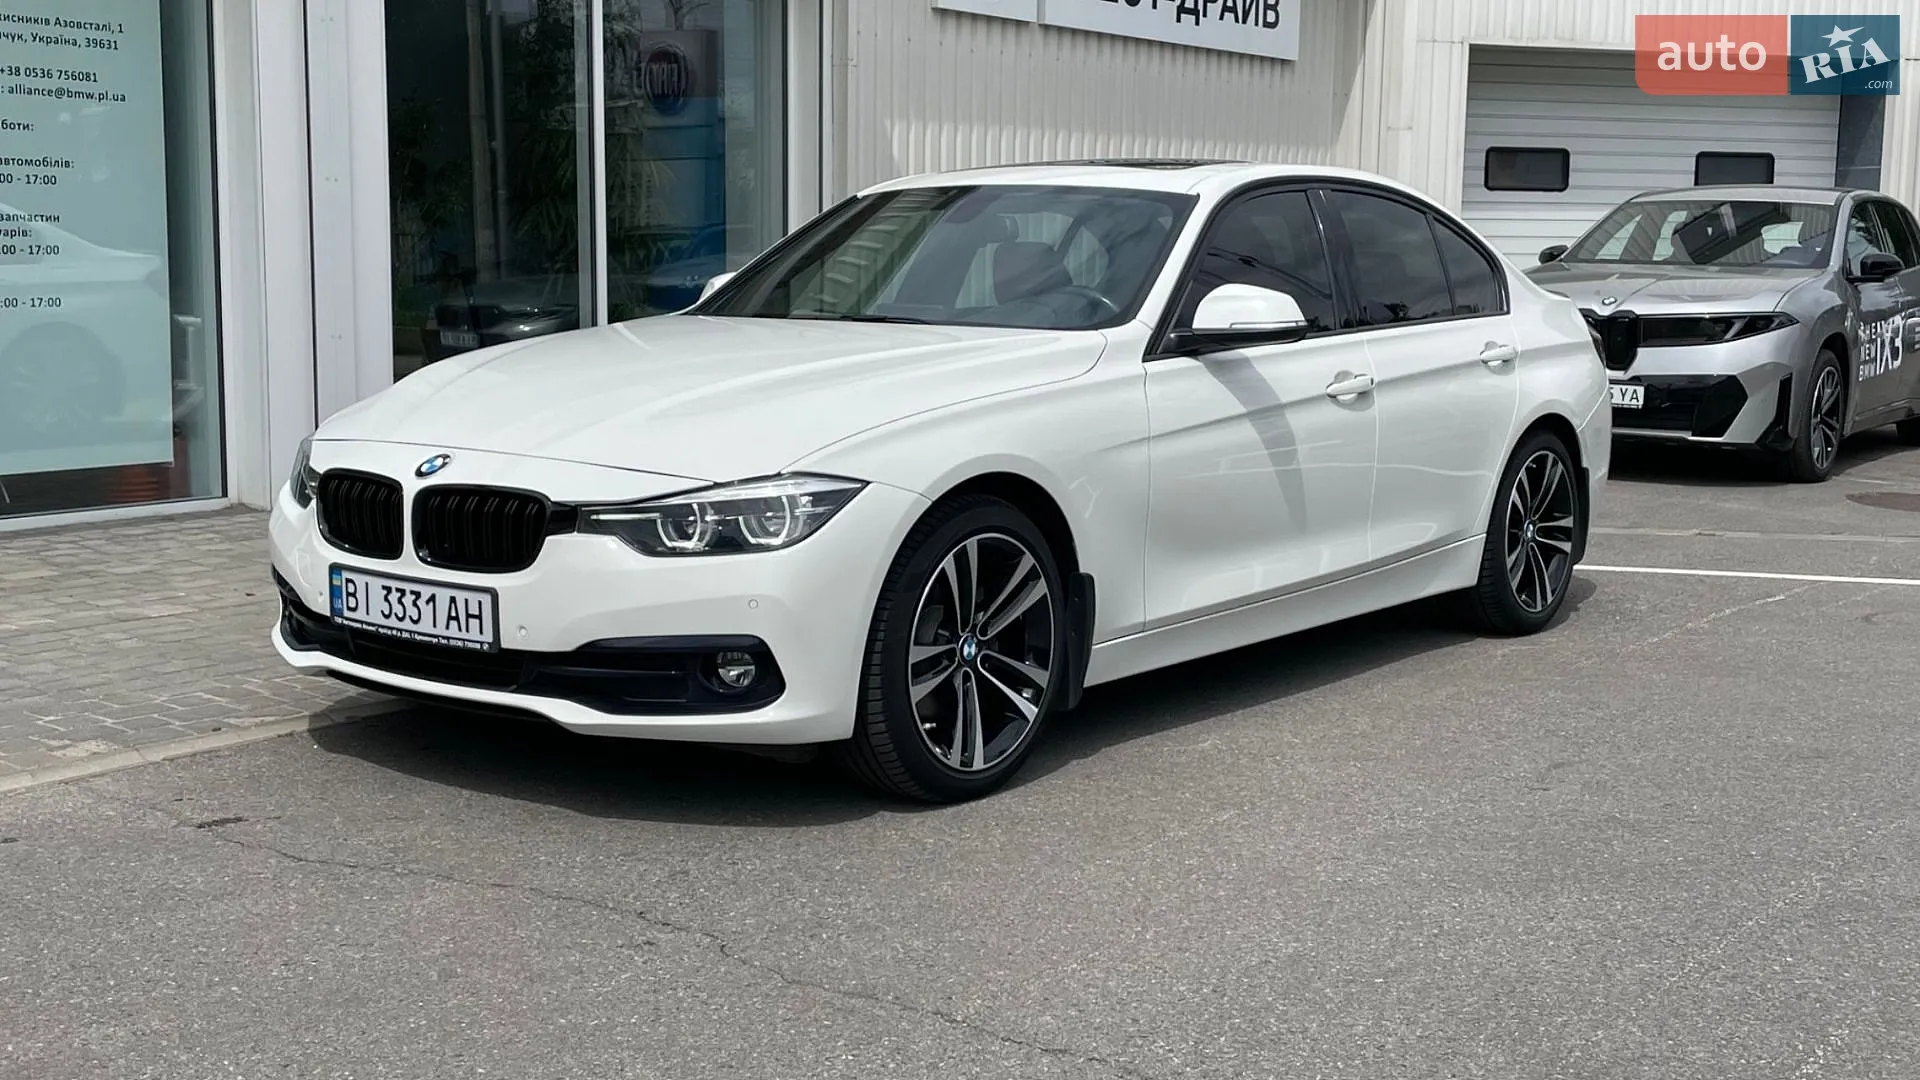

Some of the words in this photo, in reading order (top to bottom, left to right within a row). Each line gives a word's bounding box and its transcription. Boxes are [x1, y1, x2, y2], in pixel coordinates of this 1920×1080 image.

[0, 12, 51, 26] исників
[54, 17, 115, 34] Азовсталі,
[117, 23, 124, 34] 1
[0, 31, 28, 43] чук,
[31, 32, 81, 48] Україна,
[84, 37, 118, 50] 39631
[0, 65, 21, 76] +38
[25, 68, 53, 79] 0536
[56, 71, 98, 83] 756081
[8, 84, 126, 102] alliance@bmw.pl.ua
[1, 119, 34, 132] боти:
[26, 174, 57, 186] 17:00
[0, 226, 32, 240] арів:
[28, 244, 60, 256] 17:00
[30, 297, 61, 308] 17:00
[1619, 387, 1640, 403] YA
[333, 597, 343, 609] UA
[380, 584, 437, 629] 3331
[445, 595, 484, 635] AH
